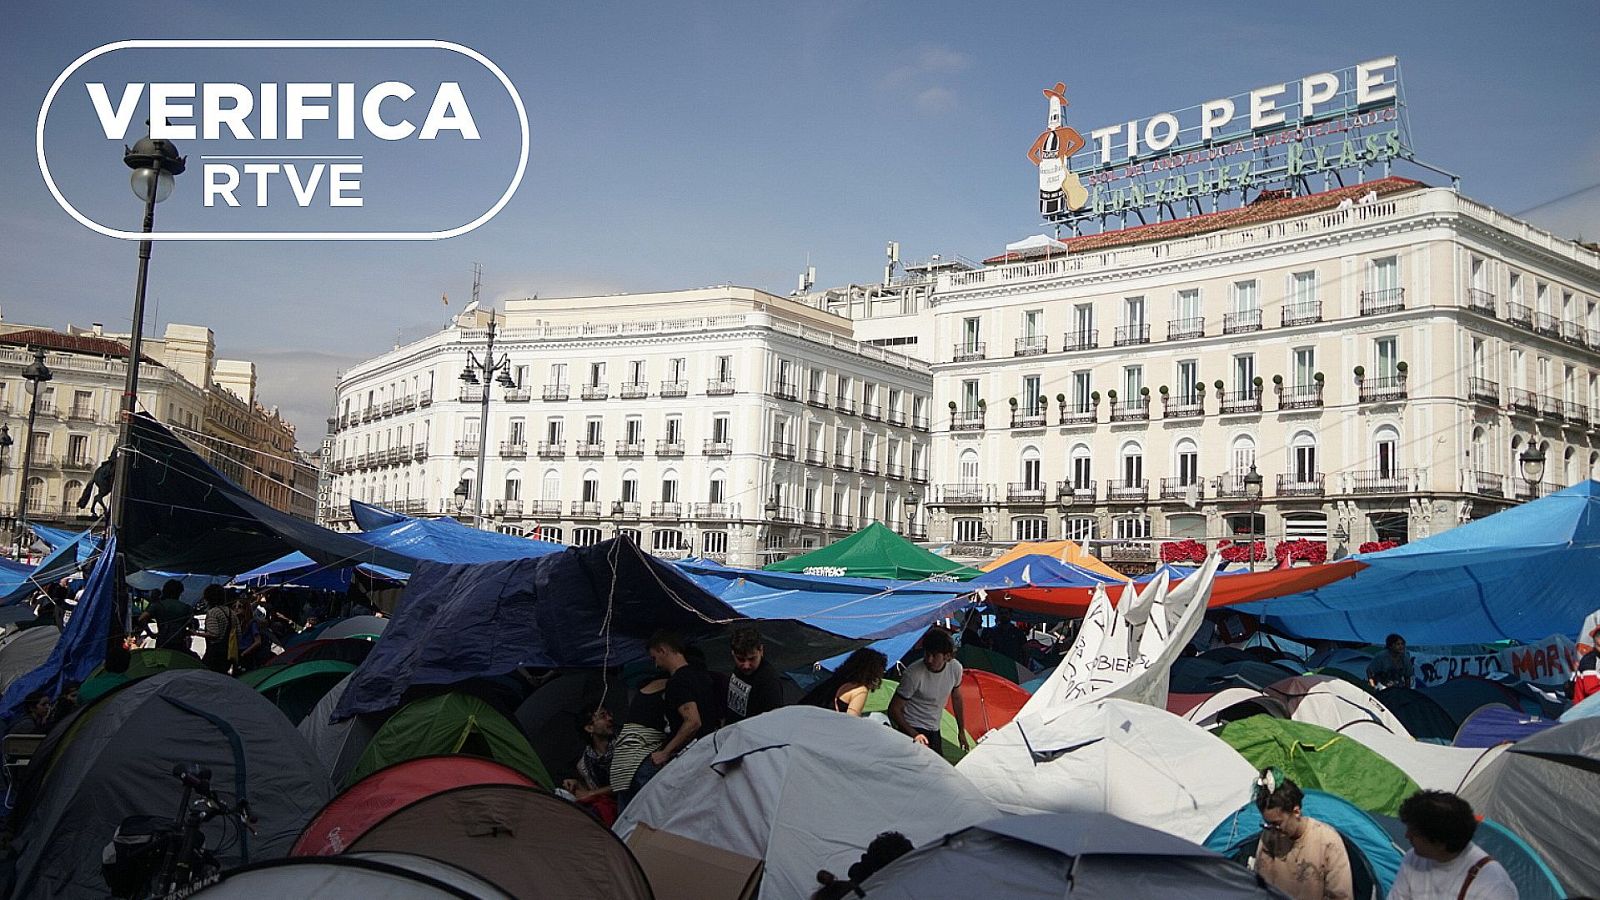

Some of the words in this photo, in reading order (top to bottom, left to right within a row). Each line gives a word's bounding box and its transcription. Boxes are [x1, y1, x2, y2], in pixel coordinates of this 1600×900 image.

[1091, 112, 1180, 163] TIO
[1202, 55, 1397, 140] PEPE
[1125, 164, 1144, 178] DE
[1253, 106, 1396, 150] EMBOTELLADO
[1287, 128, 1401, 176] BYASS
[321, 440, 332, 480] HOTEL
